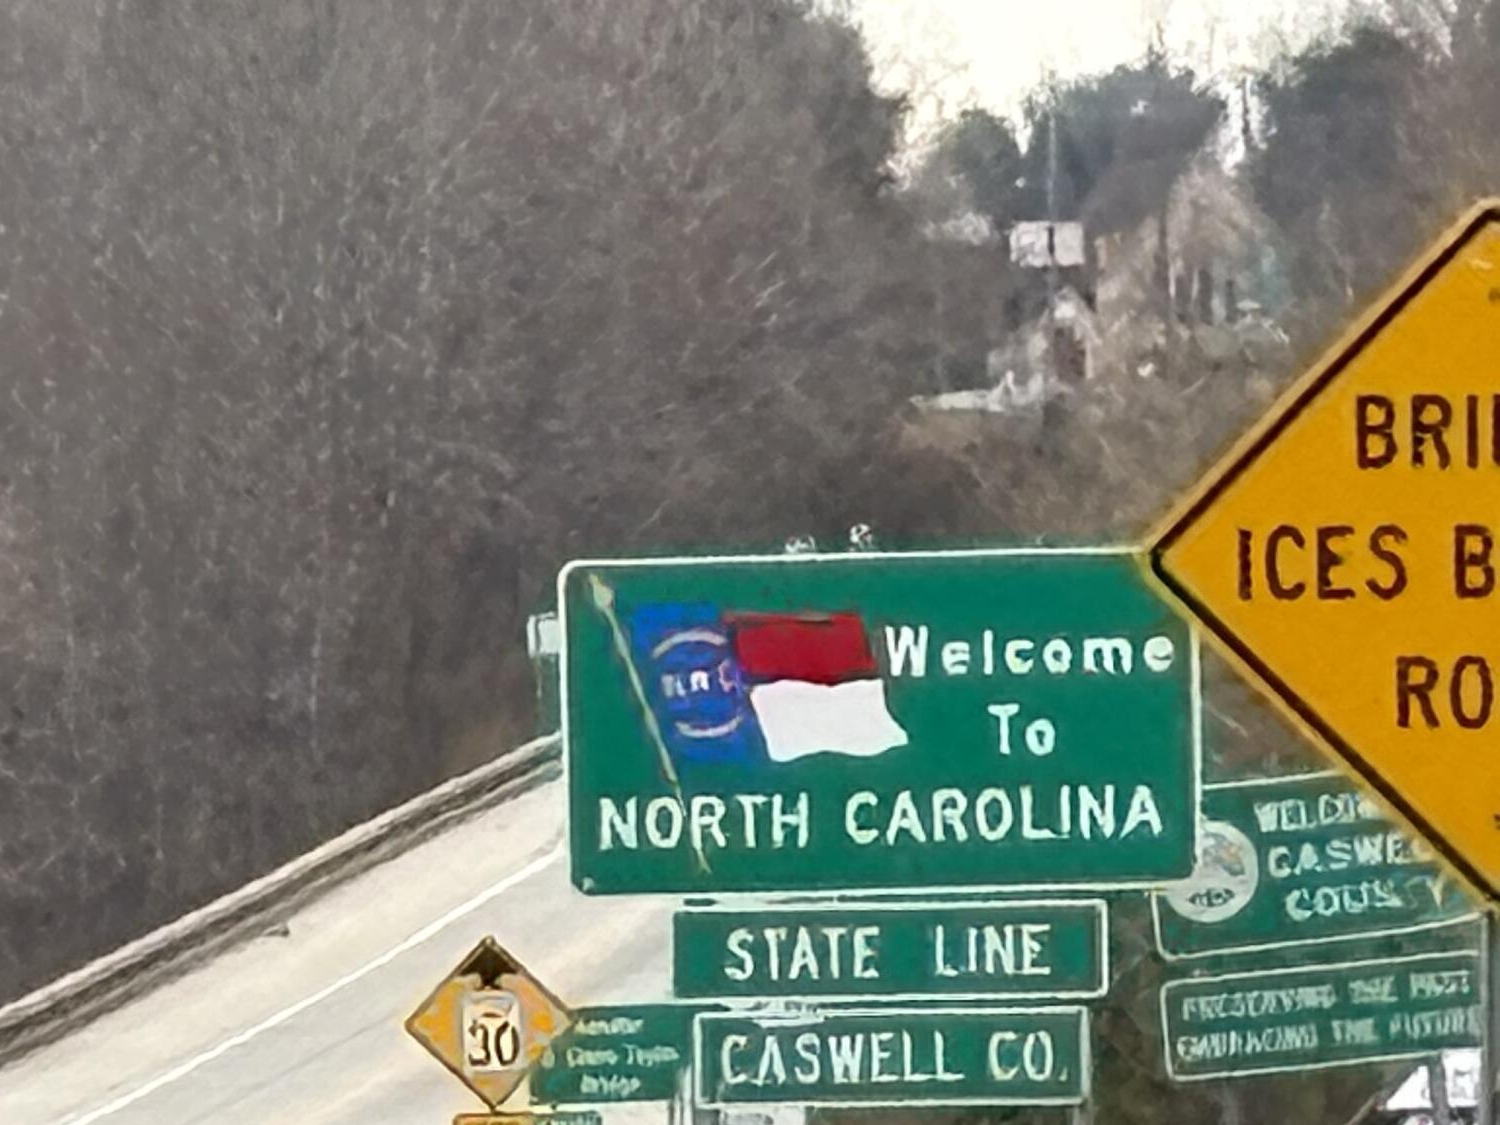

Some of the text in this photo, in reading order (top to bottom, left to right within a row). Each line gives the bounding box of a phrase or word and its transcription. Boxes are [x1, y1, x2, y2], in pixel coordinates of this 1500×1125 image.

[1356, 394, 1500, 470] BRI
[1237, 524, 1408, 601] ICES
[884, 624, 1175, 677] Welcome
[987, 703, 1056, 756] To
[599, 784, 1164, 850] NORTH CAROLINA
[723, 924, 1051, 980] STATE LINE
[468, 1018, 520, 1066] 30
[721, 1029, 965, 1087] CASWELL
[988, 1030, 1069, 1082] CO.
